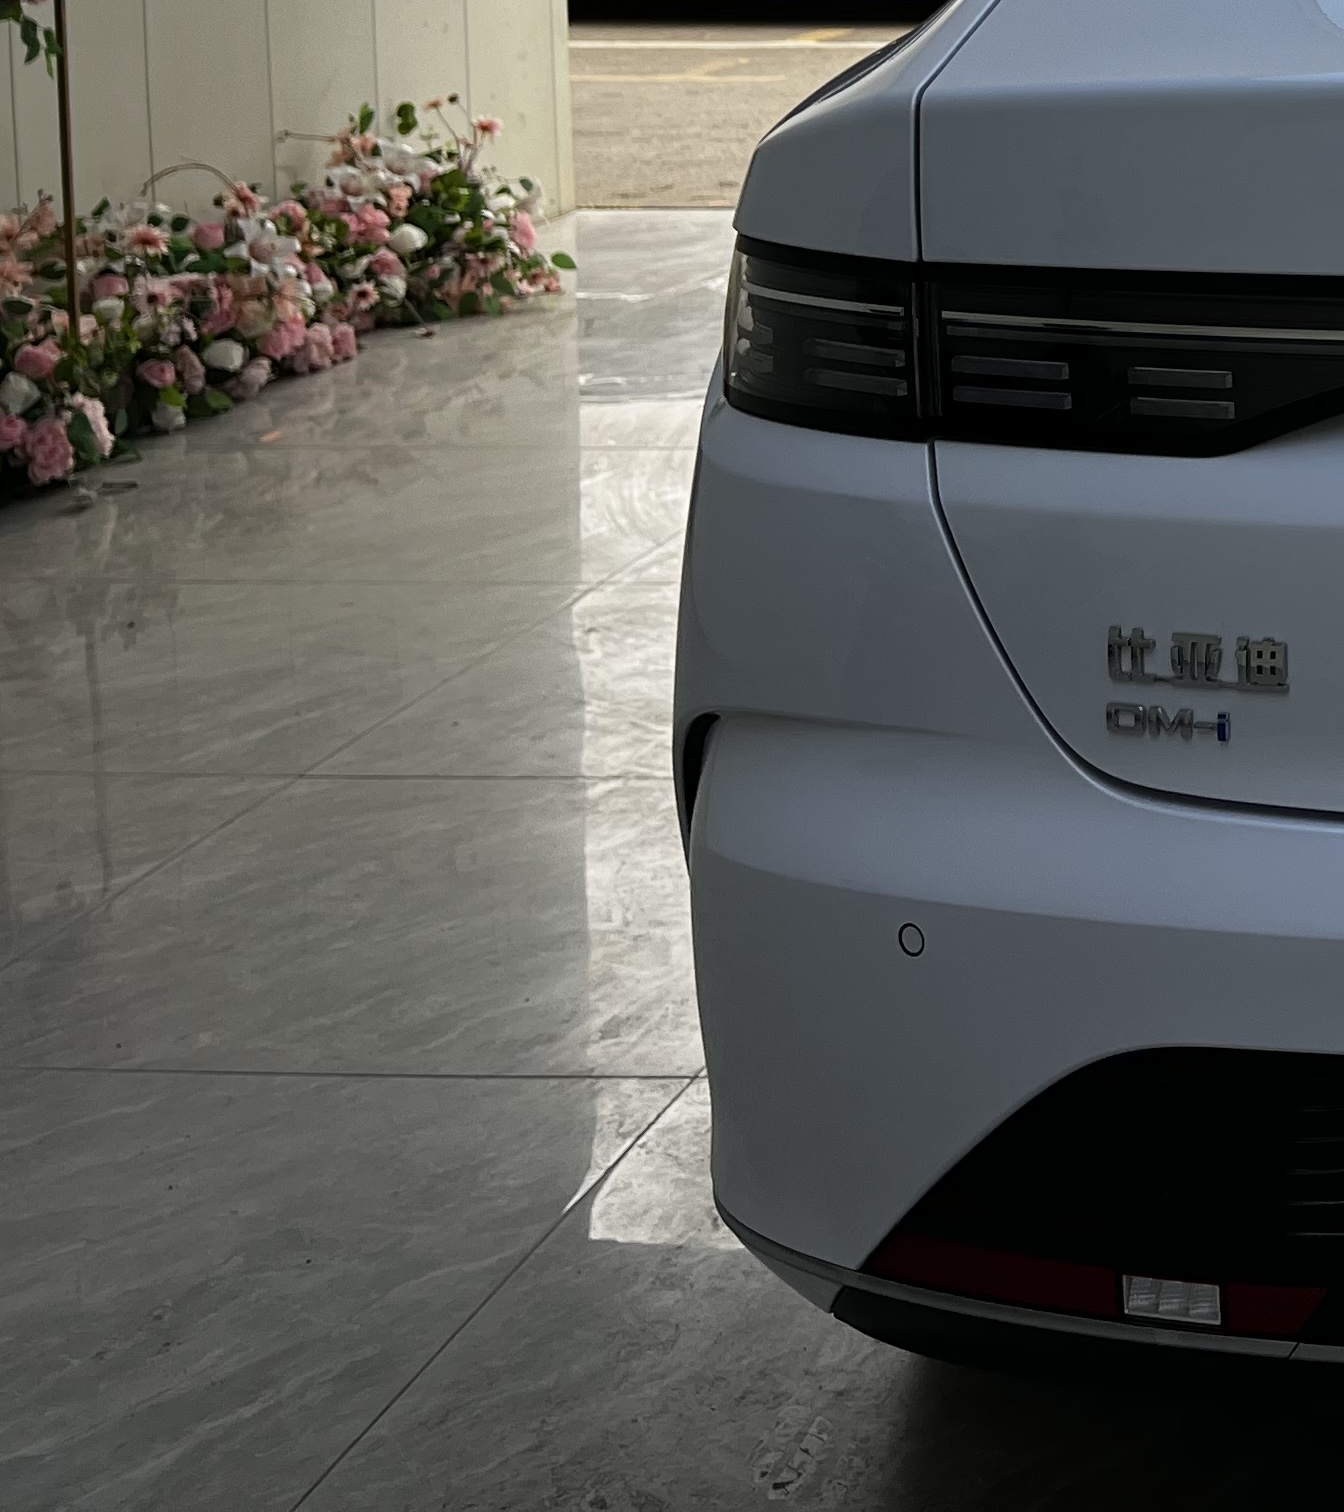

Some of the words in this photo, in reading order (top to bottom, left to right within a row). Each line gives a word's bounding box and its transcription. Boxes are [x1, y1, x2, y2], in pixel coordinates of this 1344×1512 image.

[1107, 624, 1290, 694] 比亚迪
[1105, 701, 1232, 744] DM-i
